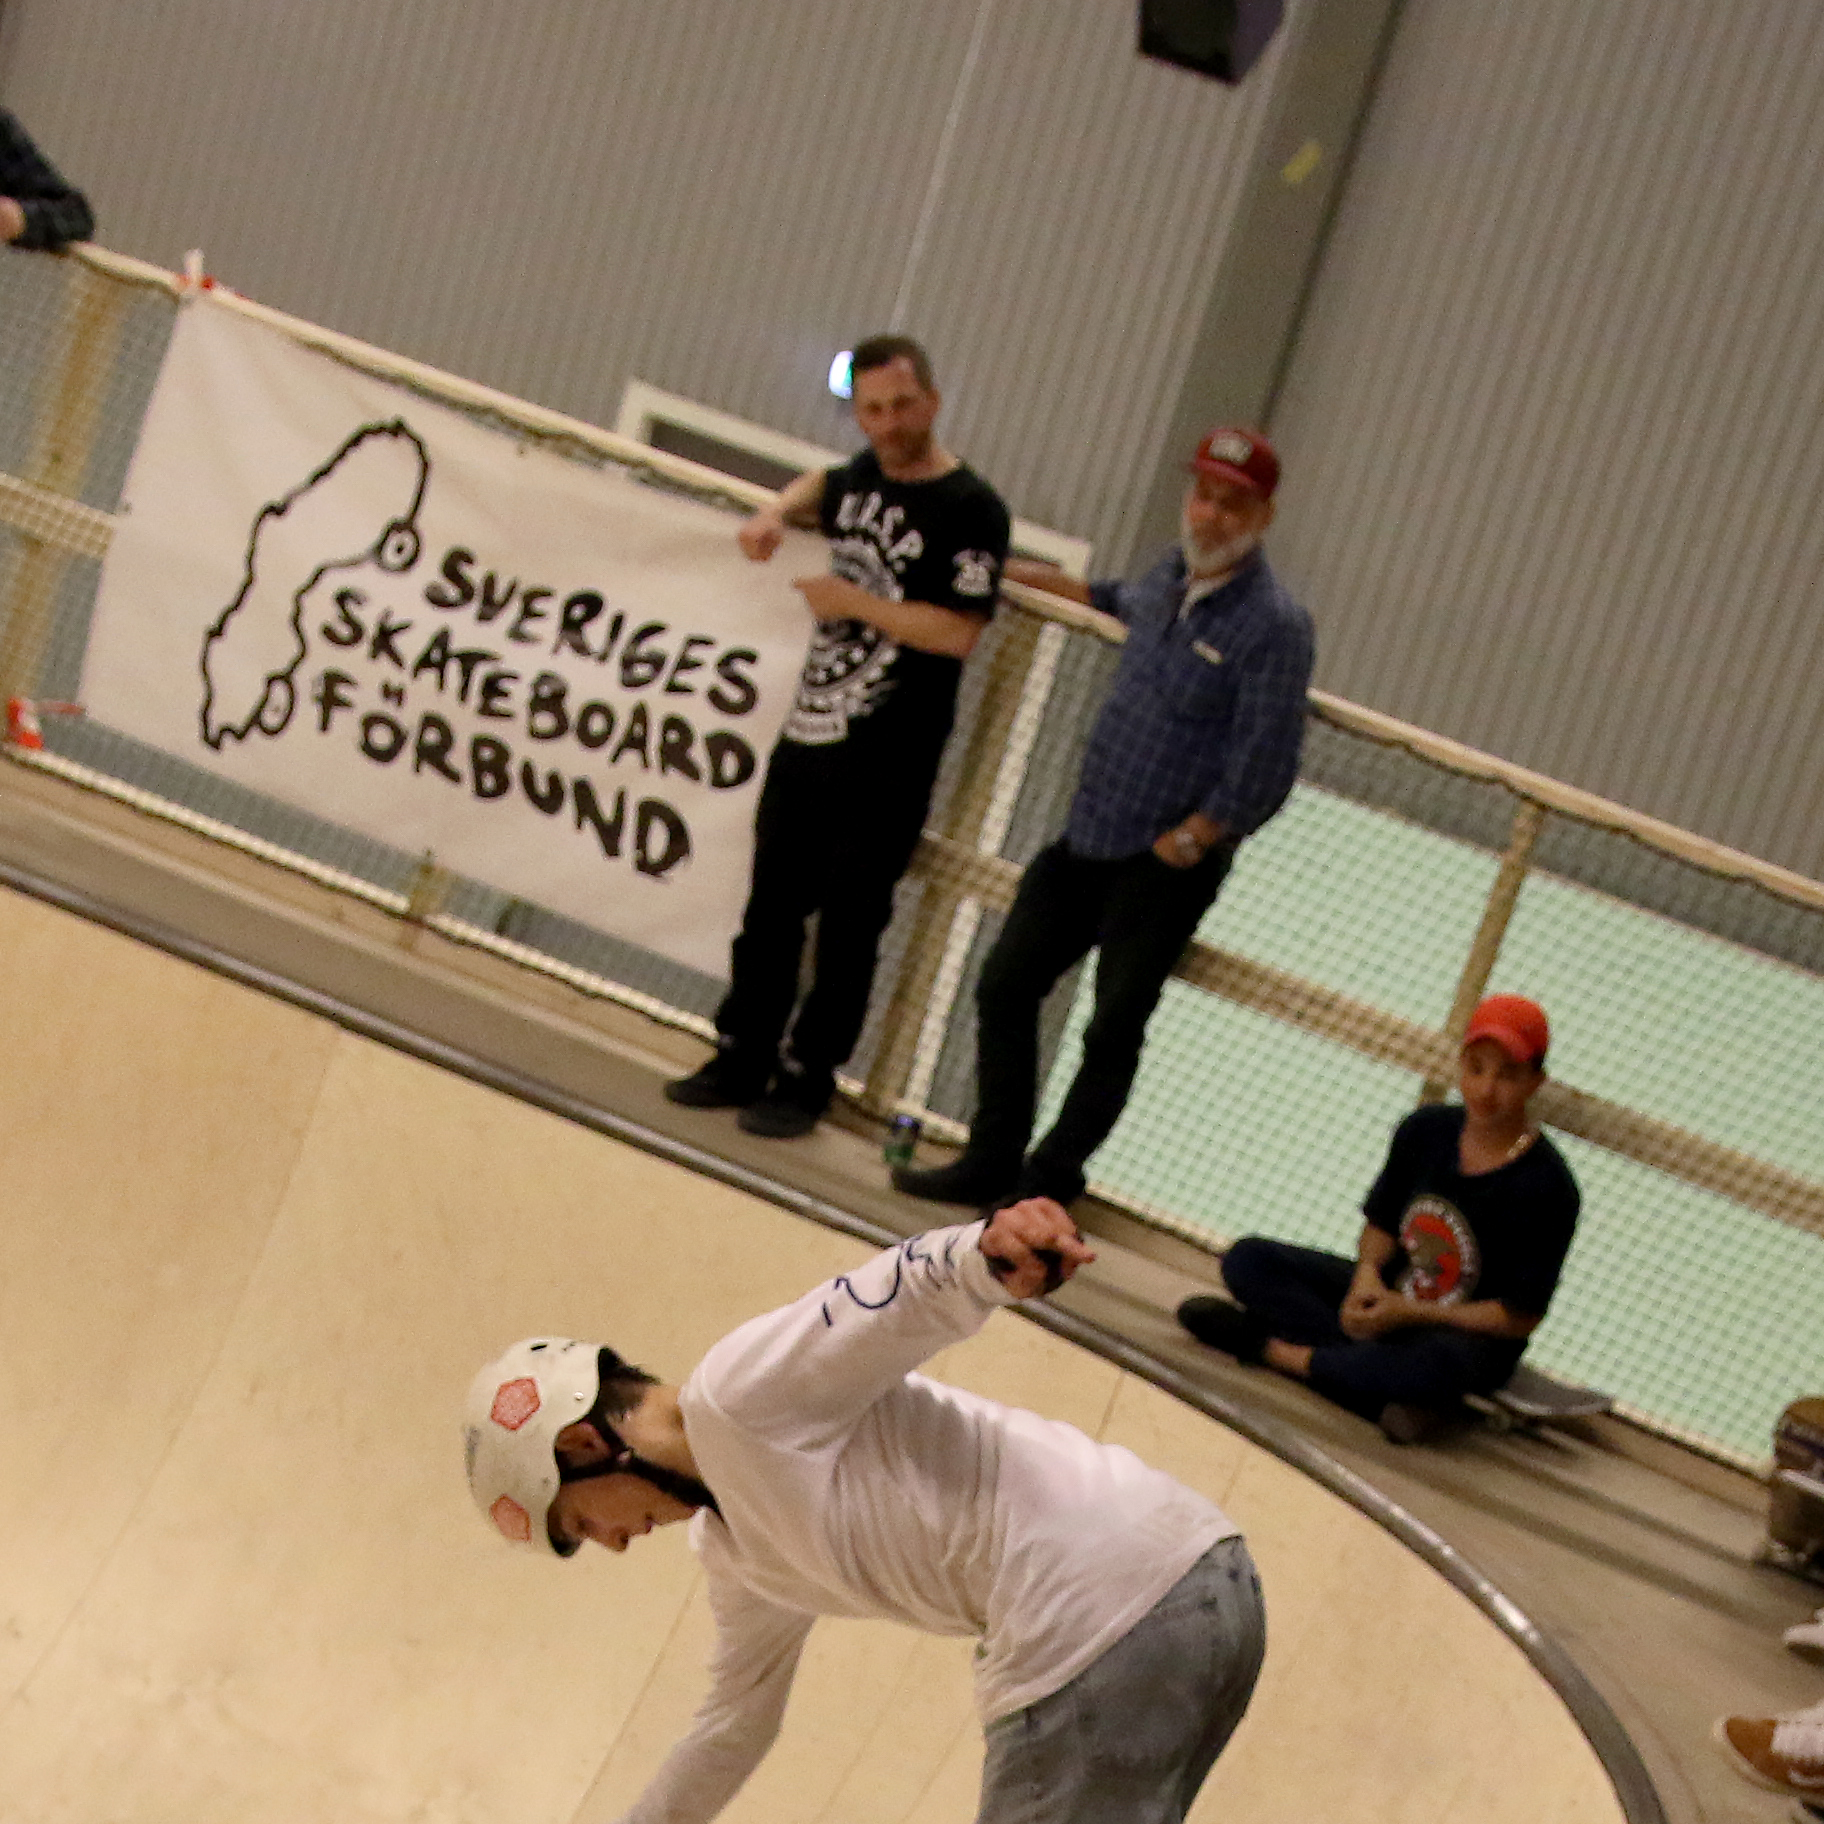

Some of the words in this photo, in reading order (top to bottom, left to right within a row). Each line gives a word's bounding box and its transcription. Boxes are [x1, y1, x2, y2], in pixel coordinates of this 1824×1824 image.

[321, 588, 755, 788] SKATEBOARD
[426, 547, 759, 715] SVERIGES
[314, 668, 690, 877] FÖRBUND
